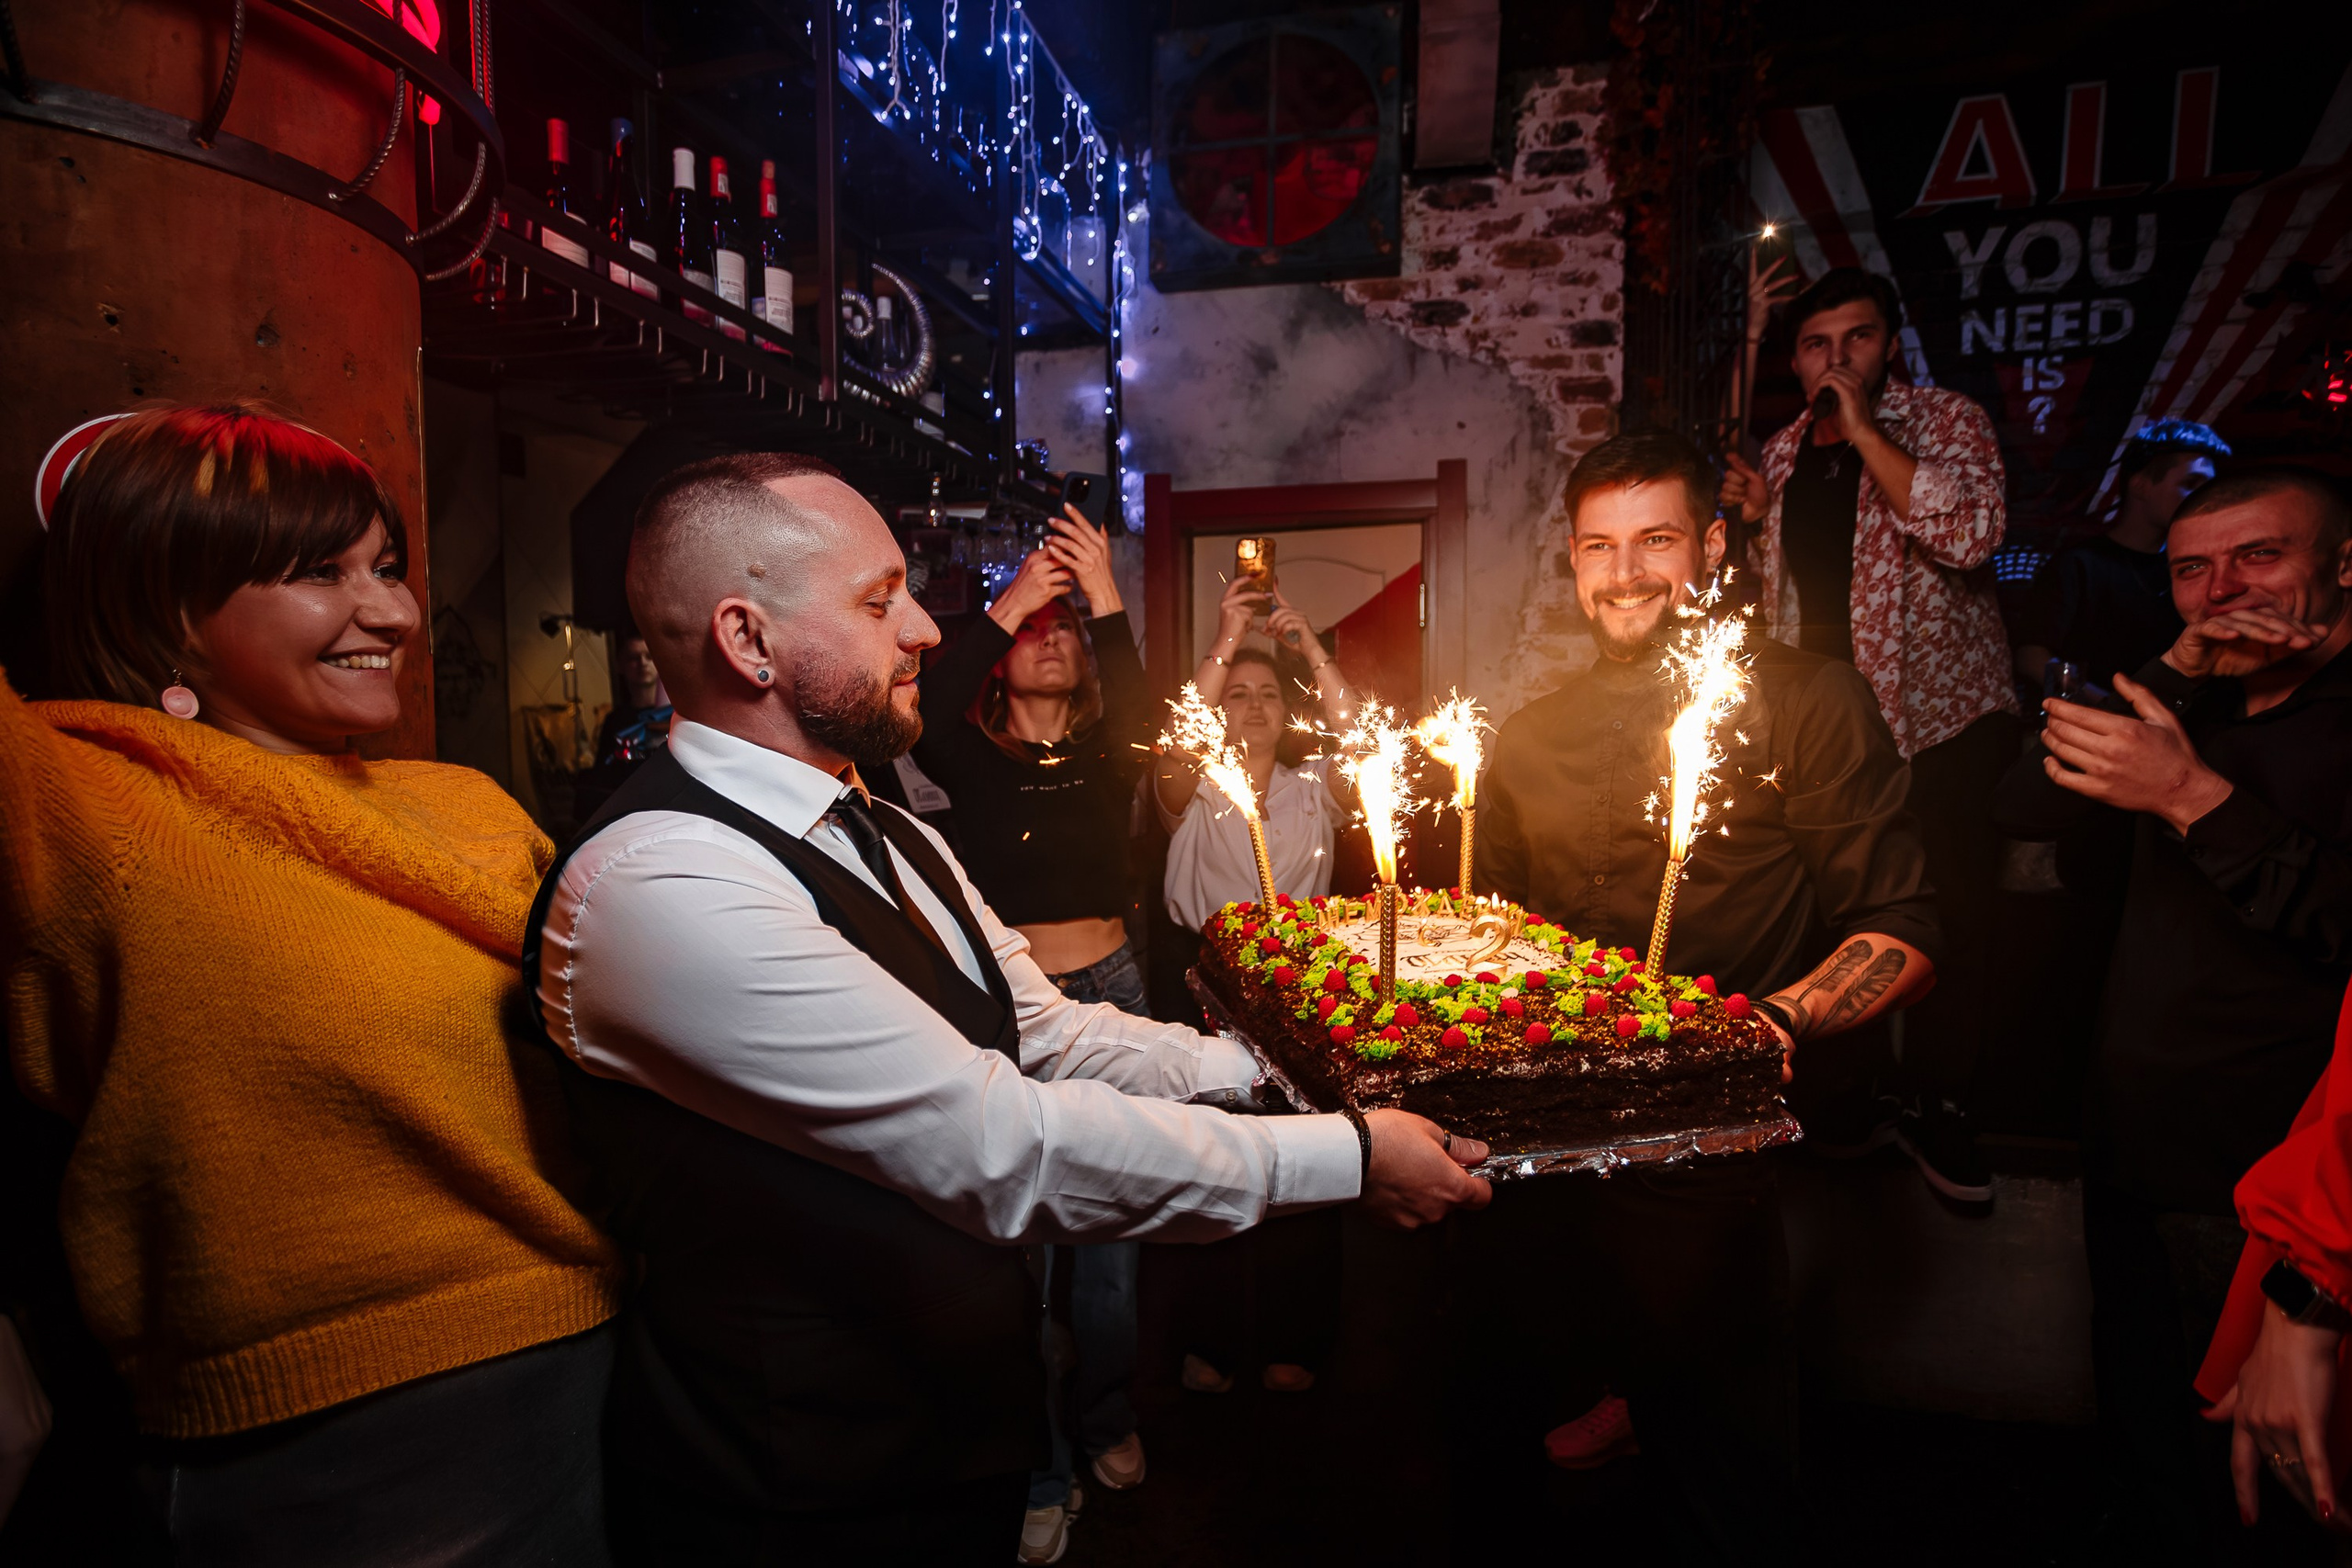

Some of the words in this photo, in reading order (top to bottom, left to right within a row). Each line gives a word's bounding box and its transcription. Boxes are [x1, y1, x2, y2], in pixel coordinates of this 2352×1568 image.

[1894, 65, 2263, 220] ALL
[1943, 212, 2158, 301] YOU
[1959, 297, 2135, 355] NEED
[2022, 354, 2067, 392] IS
[2027, 395, 2056, 434] ?
[1465, 915, 1511, 975] 2
